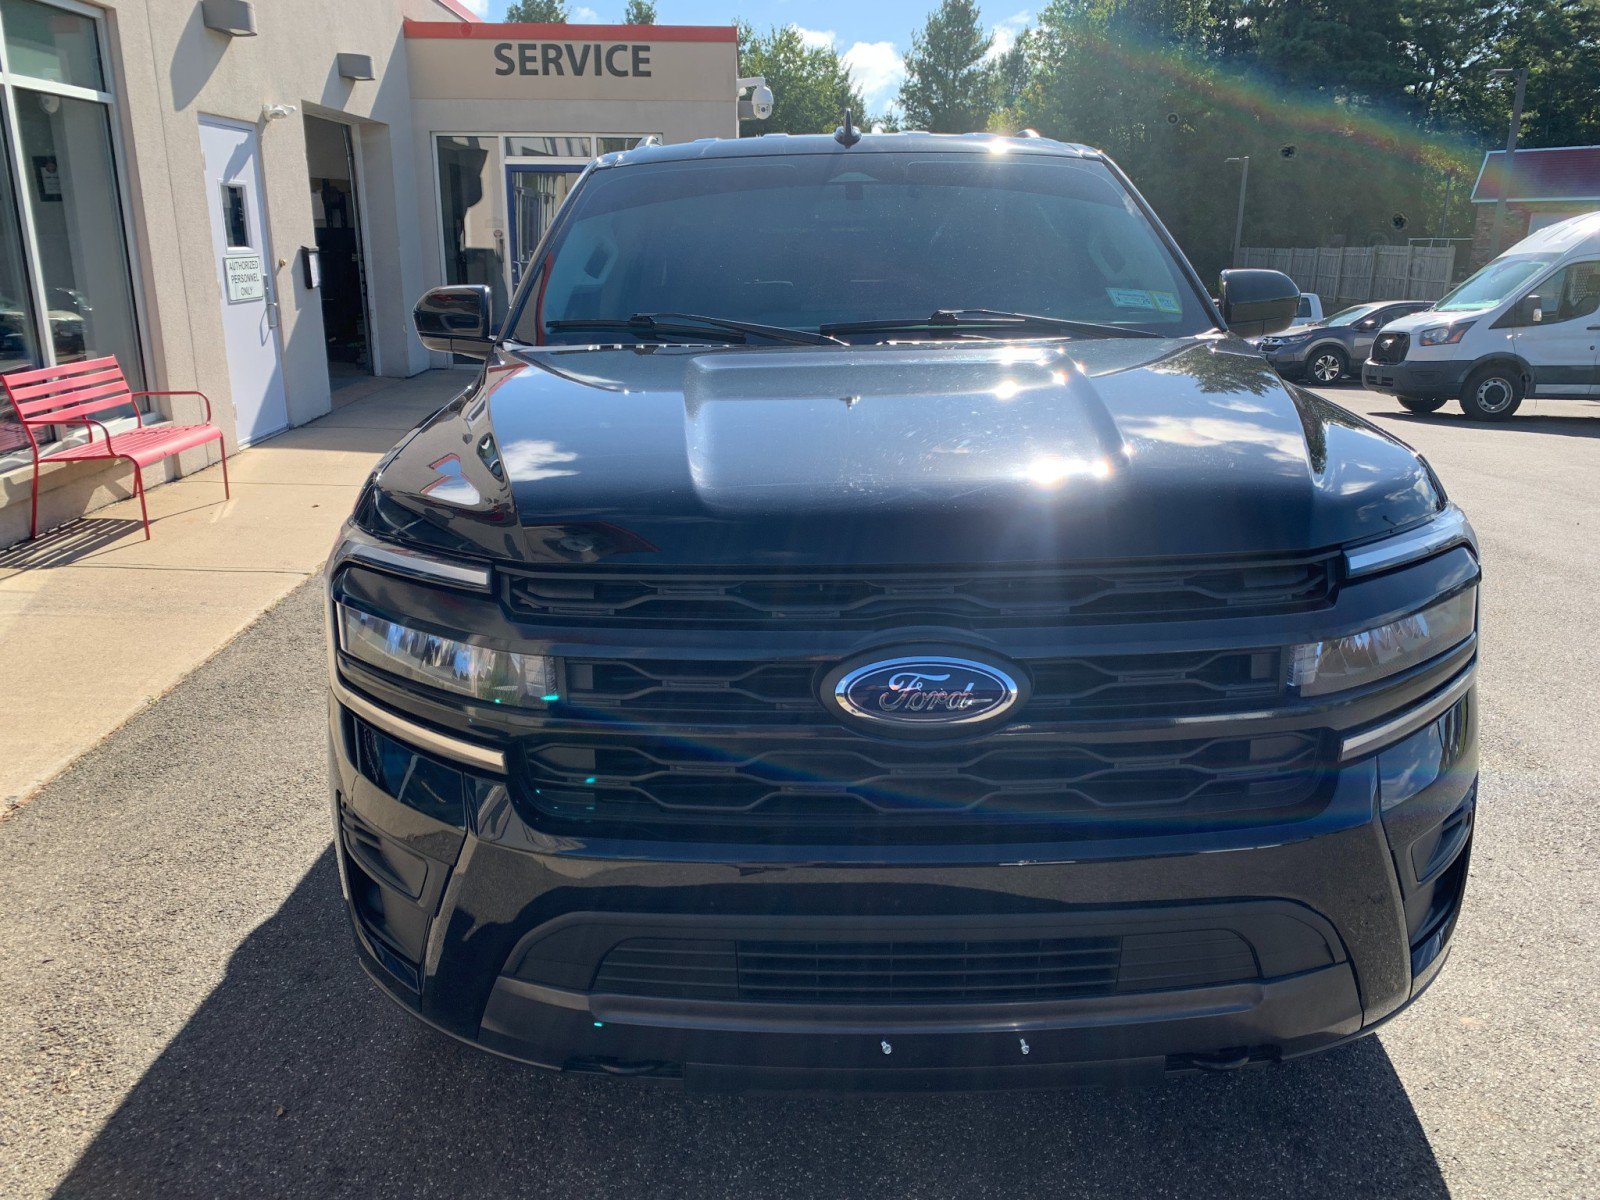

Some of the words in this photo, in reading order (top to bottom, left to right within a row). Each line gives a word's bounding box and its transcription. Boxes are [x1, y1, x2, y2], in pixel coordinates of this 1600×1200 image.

[494, 42, 652, 77] SERVICE
[229, 260, 259, 271] AUTHORIZED
[231, 273, 260, 284] PERSONNEL
[241, 286, 253, 296] ONLY
[878, 672, 993, 712] Ford
